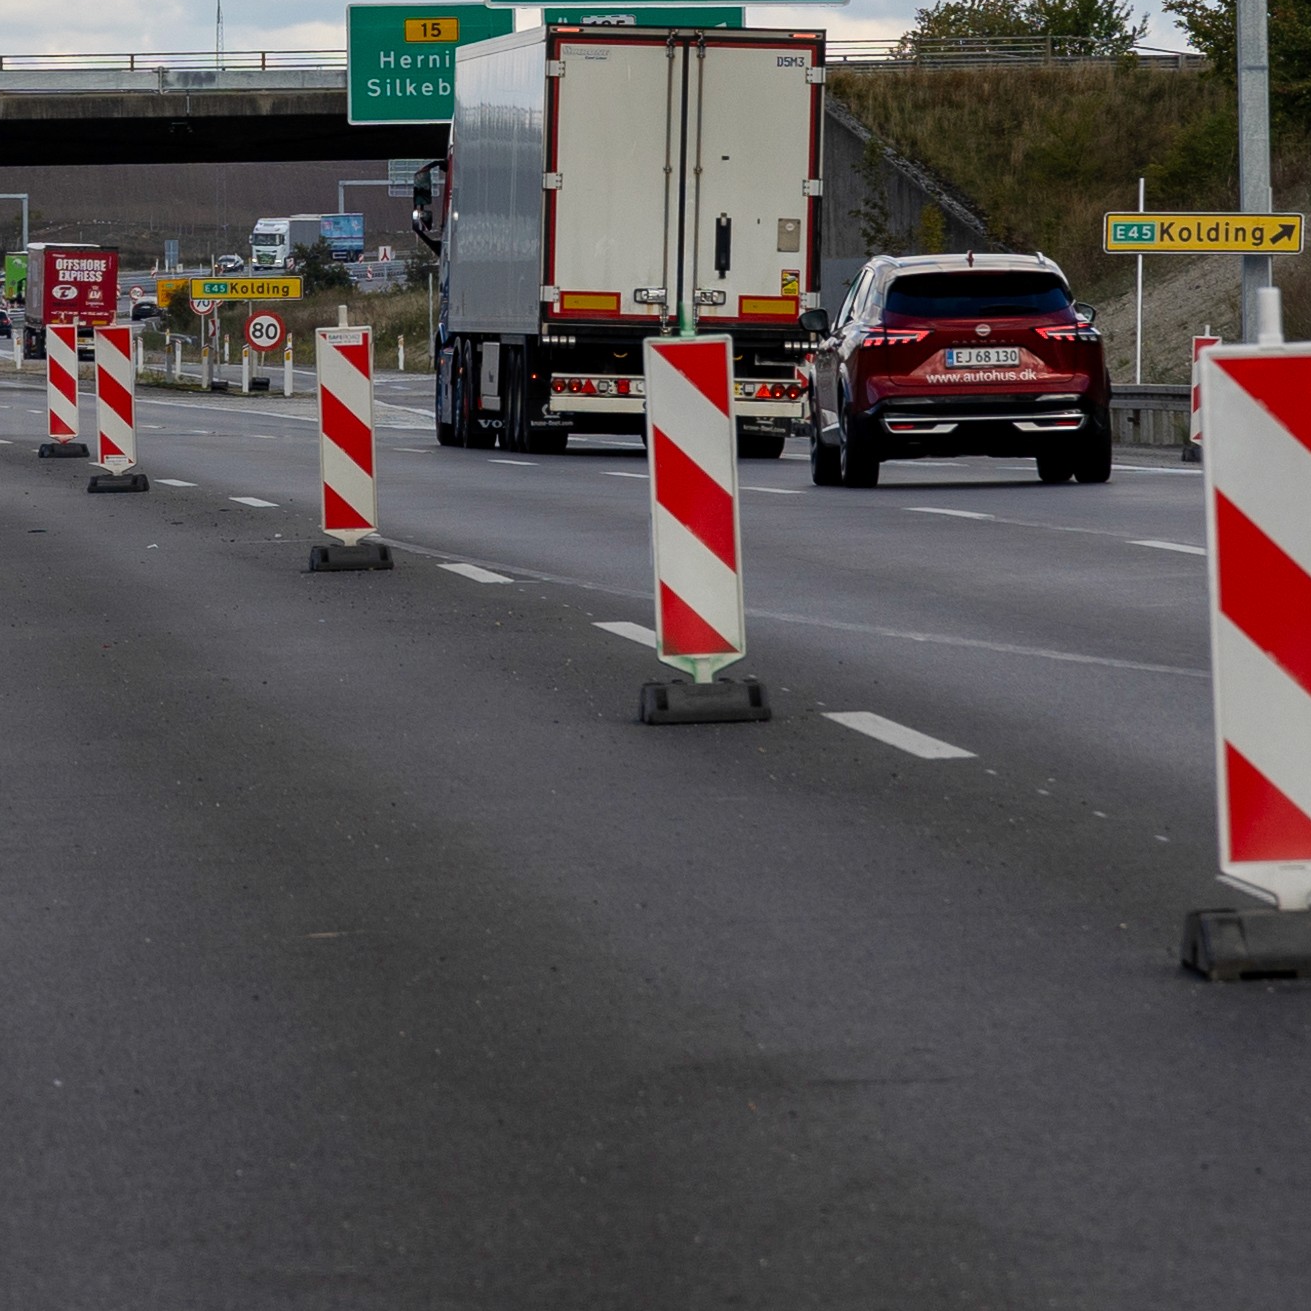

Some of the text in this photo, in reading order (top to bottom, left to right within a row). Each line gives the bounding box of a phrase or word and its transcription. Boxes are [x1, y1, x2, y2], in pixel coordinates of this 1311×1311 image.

[421, 23, 442, 38] 15
[380, 50, 450, 69] Herni
[367, 78, 451, 97] Silkeb
[1116, 222, 1265, 246] E45 Kolding
[55, 259, 107, 271] OFFSHORE
[59, 271, 103, 282] EXPRESS
[204, 283, 290, 296] E45 Kolding
[252, 322, 278, 339] 80
[956, 350, 1017, 363] EJ 68 130
[926, 369, 1037, 384] www.autohus.dk
